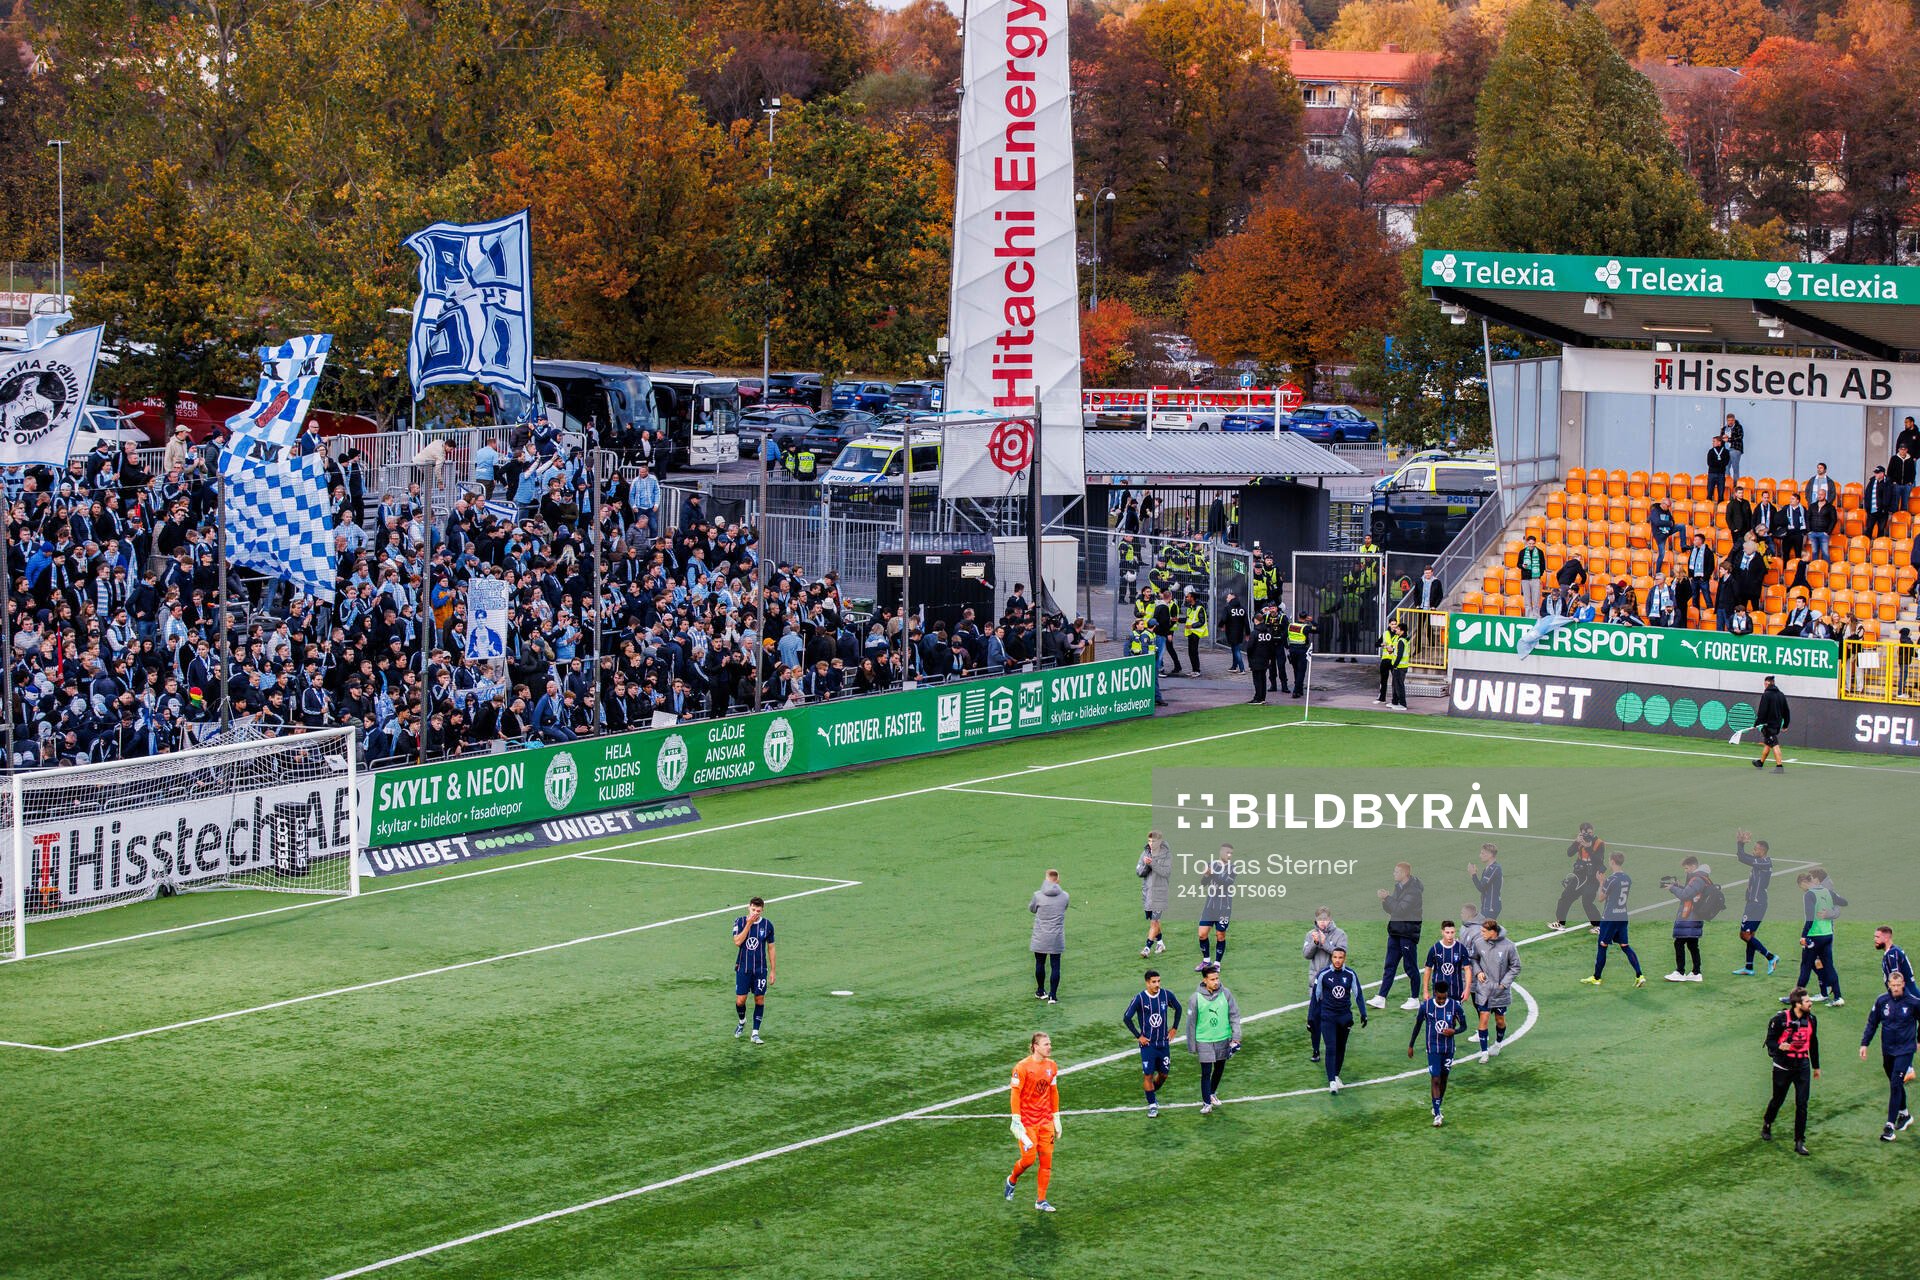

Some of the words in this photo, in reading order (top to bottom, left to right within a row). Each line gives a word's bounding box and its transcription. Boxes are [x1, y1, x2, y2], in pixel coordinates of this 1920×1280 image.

[995, 0, 1048, 191] Energy
[1461, 261, 1556, 287] Telexia
[1626, 267, 1724, 293] Telexia
[1797, 273, 1898, 299] Telexia
[992, 211, 1036, 407] Hitachi
[1678, 359, 1828, 397] Hisstech
[1840, 367, 1893, 401] AB
[1446, 495, 1474, 504] POLIS
[1231, 608, 1245, 617] SLO
[1258, 633, 1272, 642] SLO
[1704, 643, 1772, 665] FOREVER.
[1775, 647, 1834, 670] FASTER.
[1051, 673, 1094, 703] SKYLT
[1096, 671, 1108, 696] &
[1111, 664, 1152, 693] NEON
[988, 698, 1013, 726] HB
[1050, 709, 1074, 726] skyltar
[1080, 704, 1108, 719] bildekor
[1114, 698, 1152, 713] fasadvepor
[1453, 678, 1592, 720] UNIBET
[708, 723, 746, 743] GLÄDJE
[834, 718, 882, 747] FOREVER.
[885, 710, 926, 737] FASTER.
[965, 727, 984, 737] FRANK
[605, 743, 632, 760] HELA
[705, 743, 746, 763] ANSVAR
[594, 761, 640, 782] STADENS
[693, 761, 755, 784] GEMENSKAP
[379, 775, 442, 812] SKYLT
[446, 772, 461, 800] &
[466, 762, 524, 798] NEON
[599, 782, 635, 801] KLUBB!
[377, 818, 412, 837] skyltar
[420, 810, 462, 829] bildekor
[470, 801, 523, 820] fasadvepor
[541, 810, 634, 842] UNIBET
[68, 795, 276, 895] Hisstech
[305, 786, 360, 850] AB
[372, 836, 471, 872] UNIBET
[1618, 887, 1629, 906] 5
[1219, 916, 1229, 924] 25
[757, 978, 767, 989] 19
